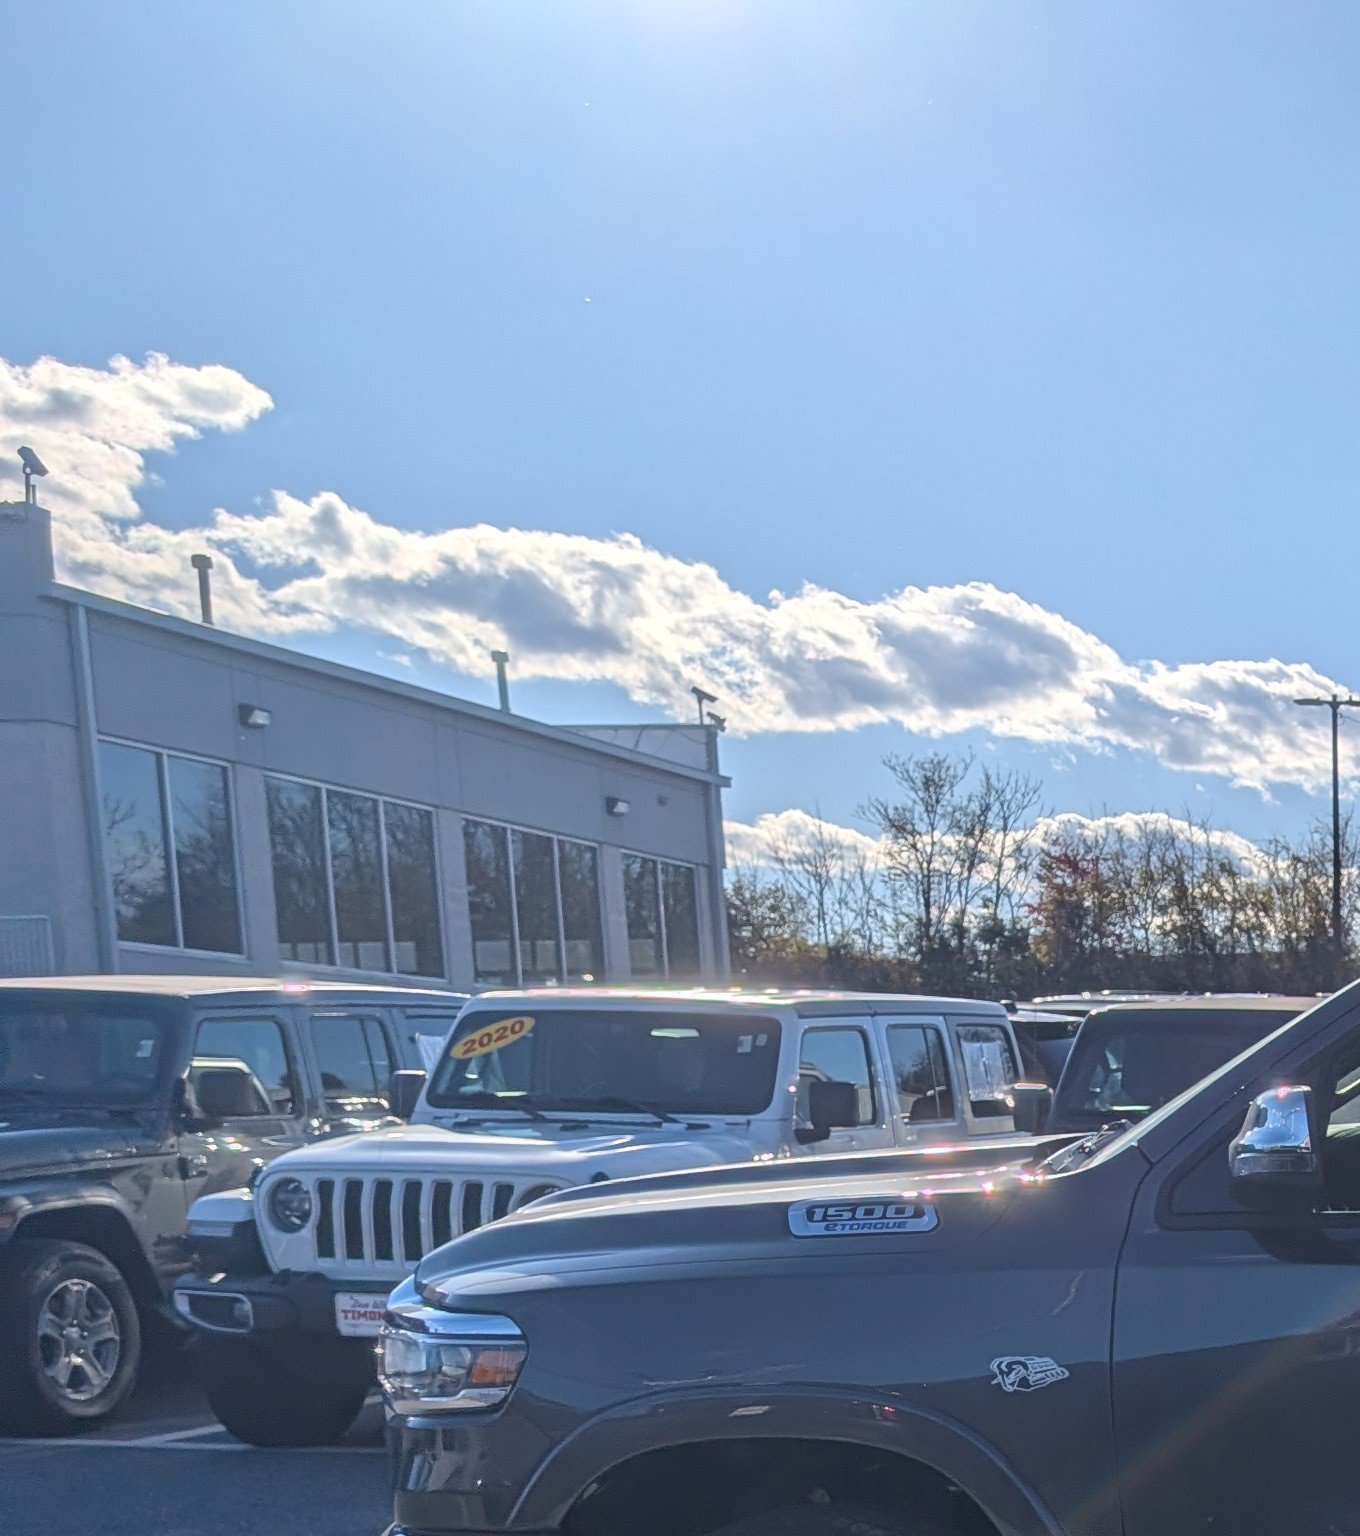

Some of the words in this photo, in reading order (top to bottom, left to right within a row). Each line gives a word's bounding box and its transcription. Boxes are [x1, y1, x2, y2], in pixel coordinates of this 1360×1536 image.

[463, 1019, 525, 1056] 2020
[812, 1204, 915, 1221] 1500
[340, 1308, 386, 1321] TIMON
